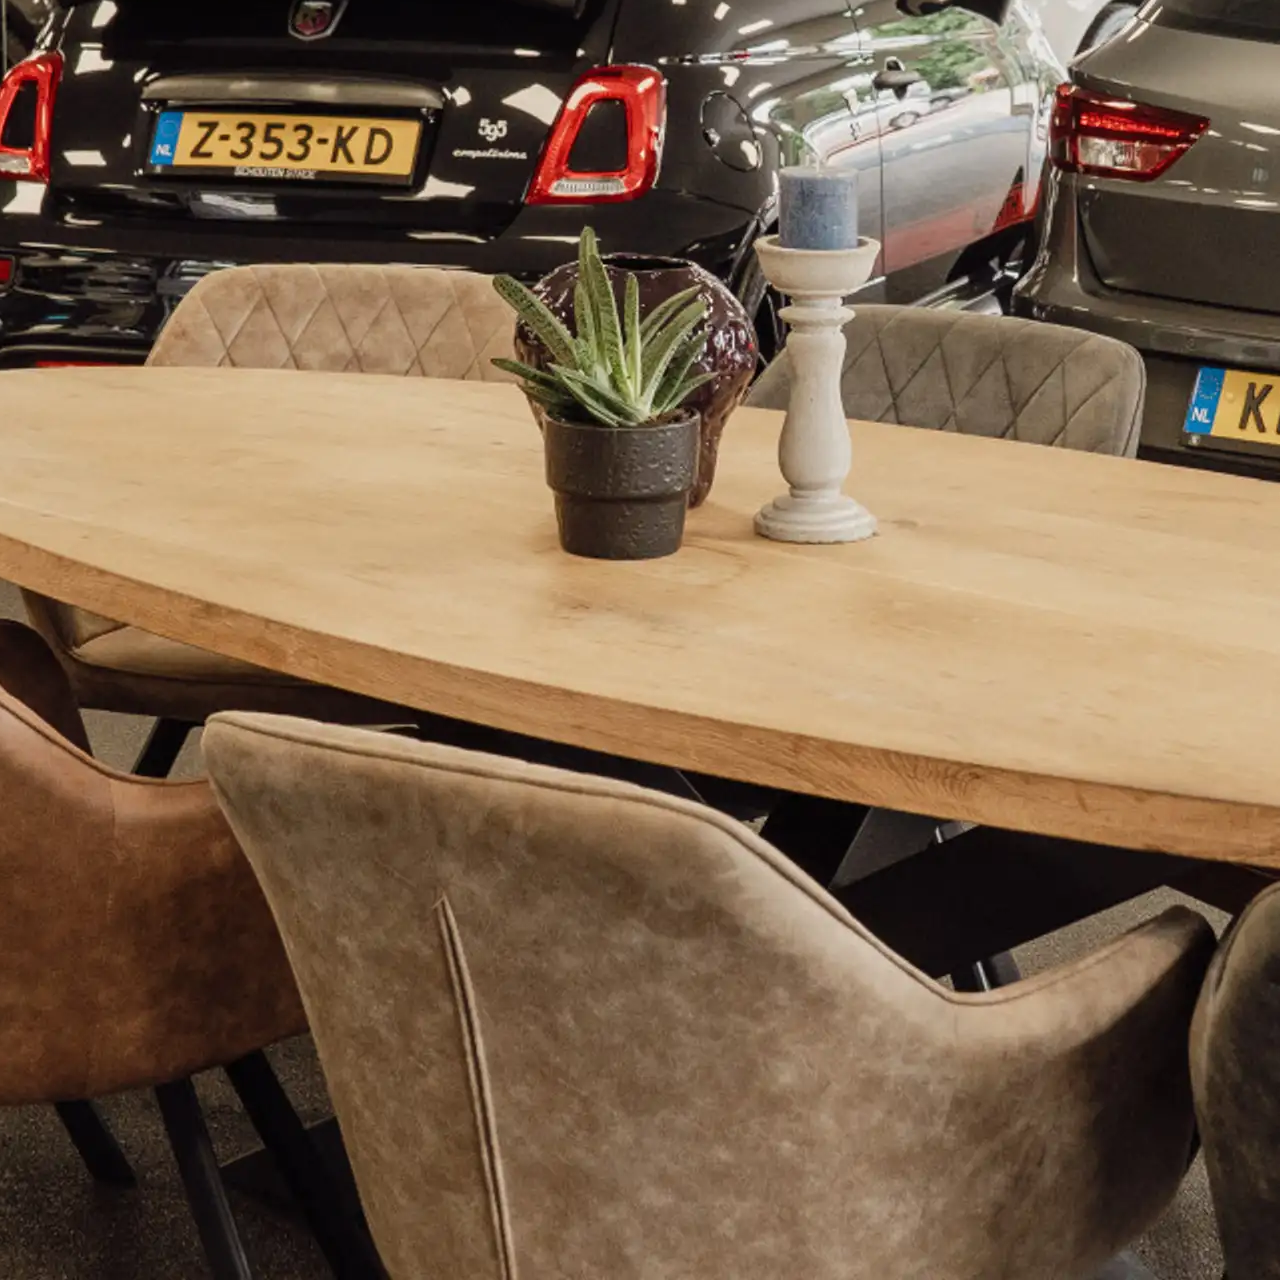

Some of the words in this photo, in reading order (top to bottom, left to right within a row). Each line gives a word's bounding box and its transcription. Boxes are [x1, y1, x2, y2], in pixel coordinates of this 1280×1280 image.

[155, 144, 172, 157] NL
[190, 121, 393, 166] Z-353-KD
[1191, 407, 1211, 424] NL
